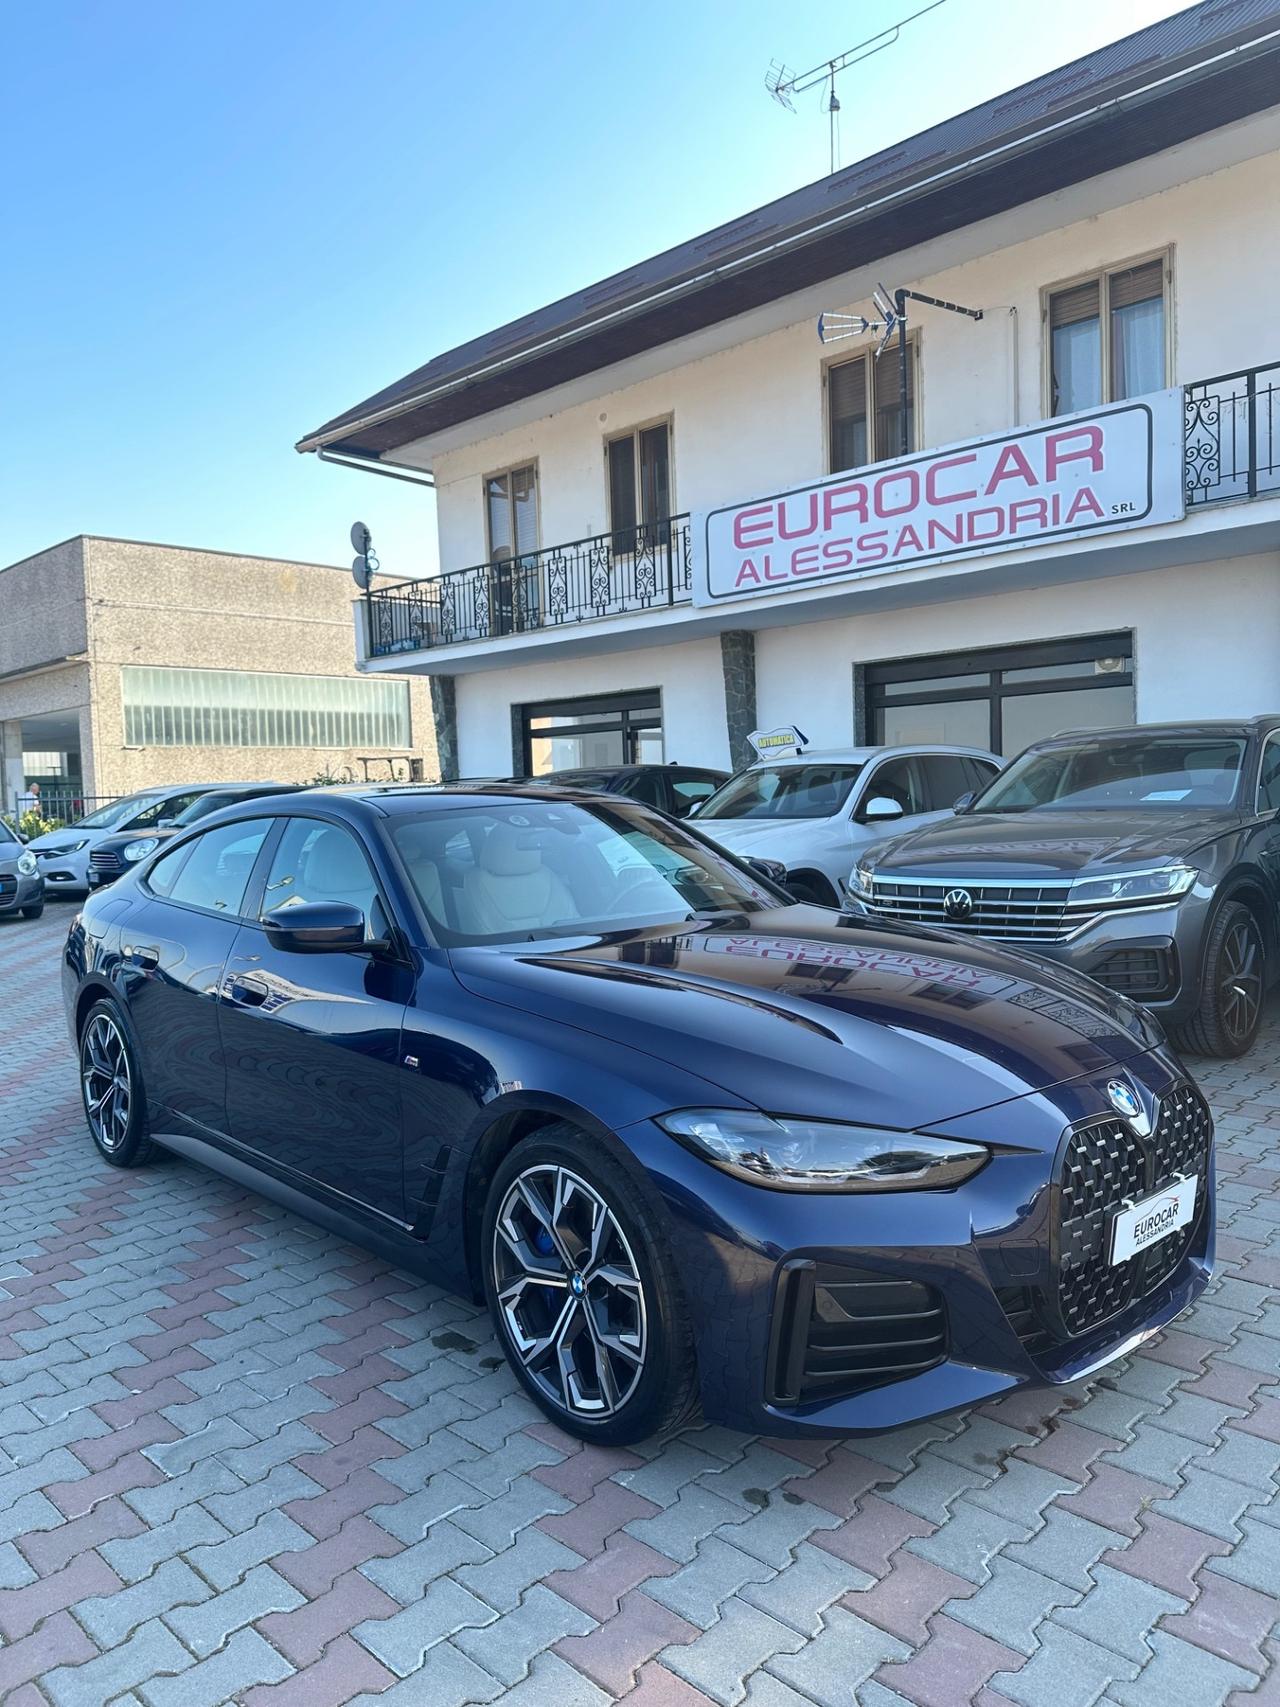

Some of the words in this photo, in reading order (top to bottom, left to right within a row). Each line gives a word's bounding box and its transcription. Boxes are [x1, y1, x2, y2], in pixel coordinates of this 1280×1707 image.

[733, 425, 1104, 550] EUROCAR
[735, 487, 1105, 588] ALESSANDRIA
[1111, 502, 1137, 515] SRL
[1133, 1203, 1179, 1239] EUROCAR
[1135, 1218, 1174, 1247] ALESSANDRIA
